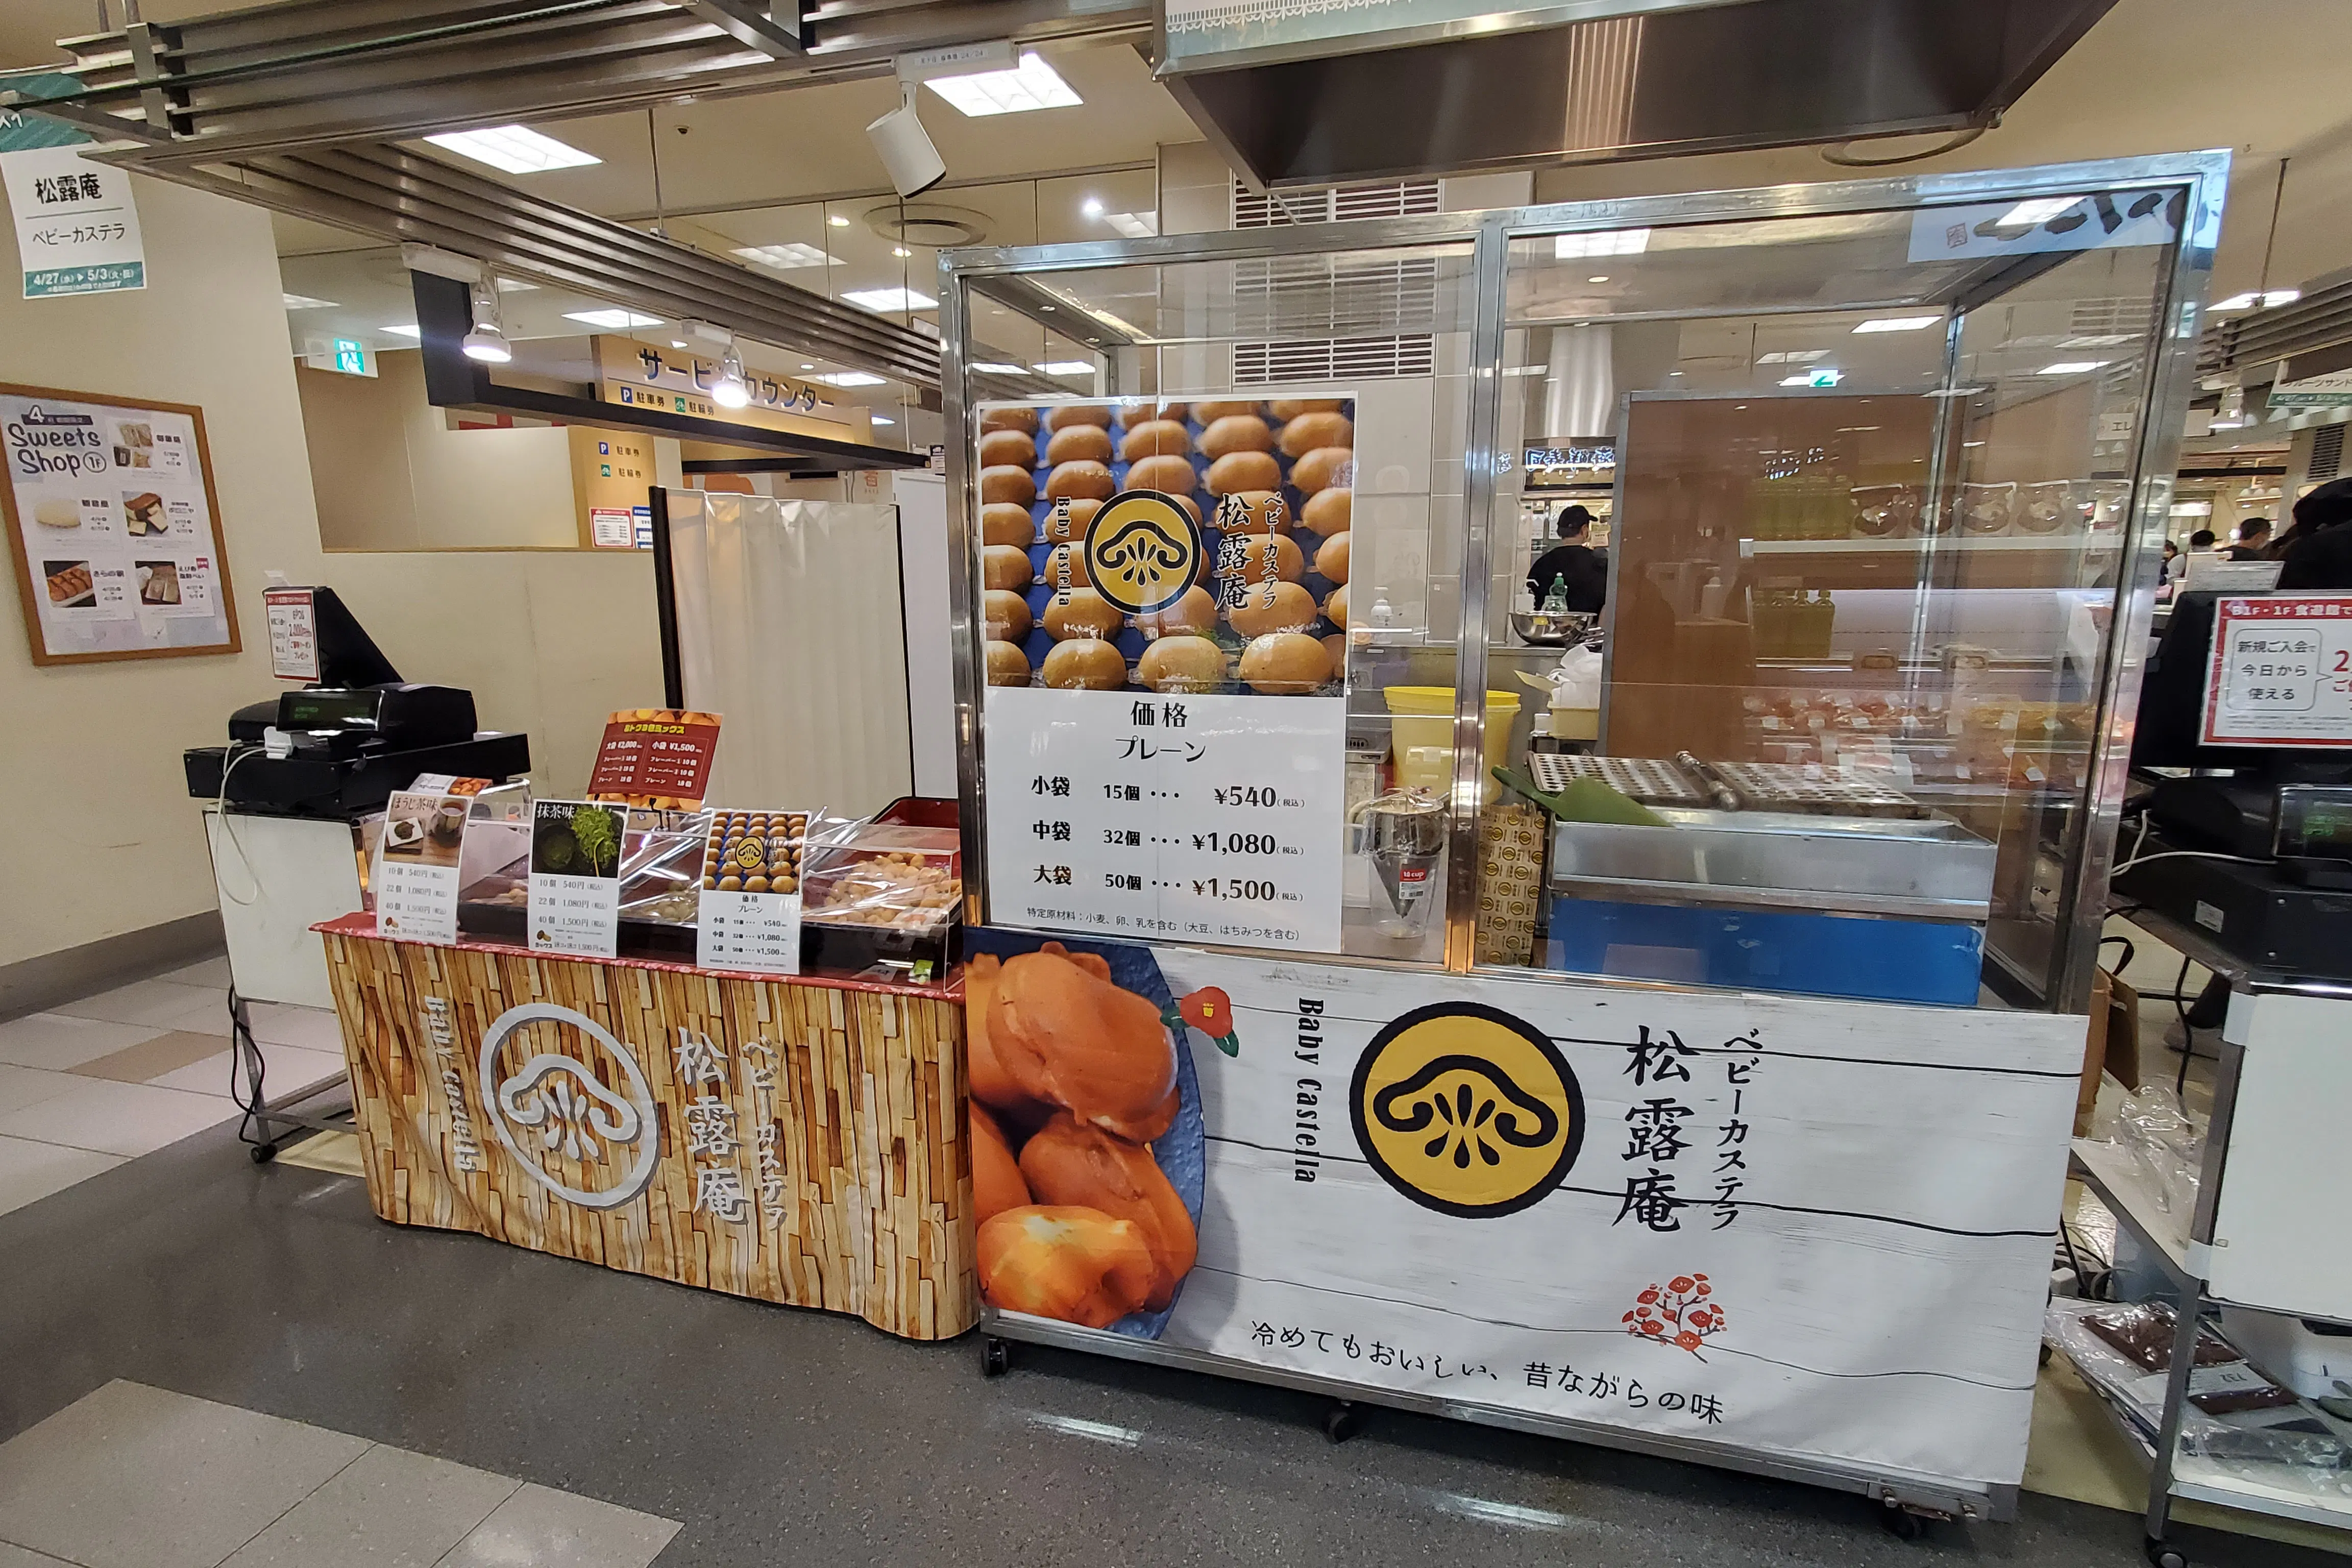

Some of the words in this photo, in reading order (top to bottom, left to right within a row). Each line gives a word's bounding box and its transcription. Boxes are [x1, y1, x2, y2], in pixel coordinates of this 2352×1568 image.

[35, 173, 103, 204] 松露庵
[32, 223, 126, 246] ベビーカステラ
[636, 348, 835, 413] サービカウンター
[636, 391, 665, 408] 駐車券
[8, 423, 101, 447] Sweets
[17, 449, 81, 478] Shop
[1055, 496, 1071, 538] Baby
[1215, 493, 1254, 610] 松露庵
[1262, 492, 1284, 610] ベビーカステラ
[1057, 543, 1071, 606] Castella
[2241, 664, 2308, 677] 今日から
[2248, 688, 2295, 700] 使える
[1130, 700, 1188, 728] 価格
[1115, 736, 1206, 763] プレーン
[1031, 775, 1070, 797] 小袋
[391, 797, 439, 811] ほうじ茶味
[536, 803, 575, 820] 抹茶味
[1033, 820, 1071, 842] 中袋
[1033, 864, 1072, 886] 大袋
[738, 904, 763, 914] プレーン
[1294, 997, 1325, 1066] Baby
[673, 1025, 753, 1224] 松露庵
[742, 1034, 788, 1231] ベビーカステラ
[1294, 1078, 1324, 1184] Castella
[1611, 1024, 1701, 1233] 松露庵
[1710, 1027, 1763, 1231] ベビーカステラ
[1251, 1319, 1724, 1425] 冷めてもおいしい、昔ながらの味
